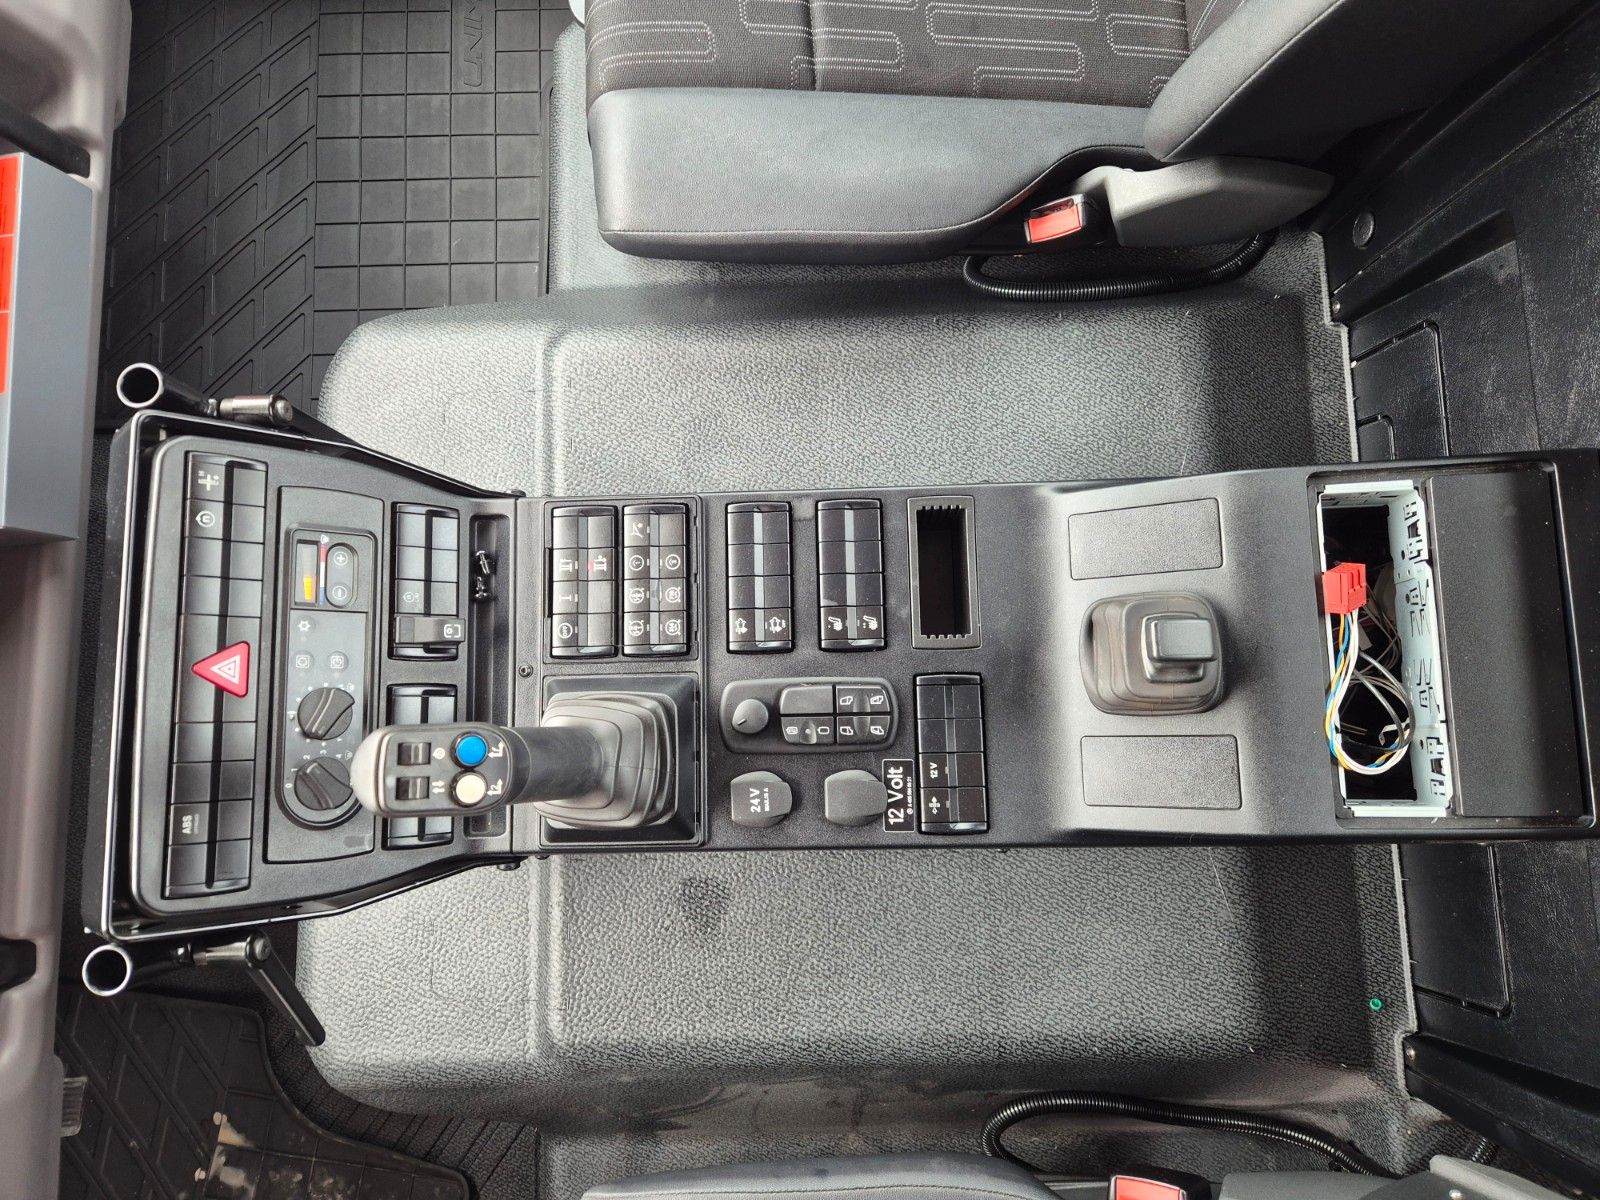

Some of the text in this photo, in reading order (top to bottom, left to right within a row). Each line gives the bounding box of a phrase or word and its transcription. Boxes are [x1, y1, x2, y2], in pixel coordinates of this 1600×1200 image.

[886, 766, 904, 826] 12 Volt
[181, 815, 193, 834] ABS
